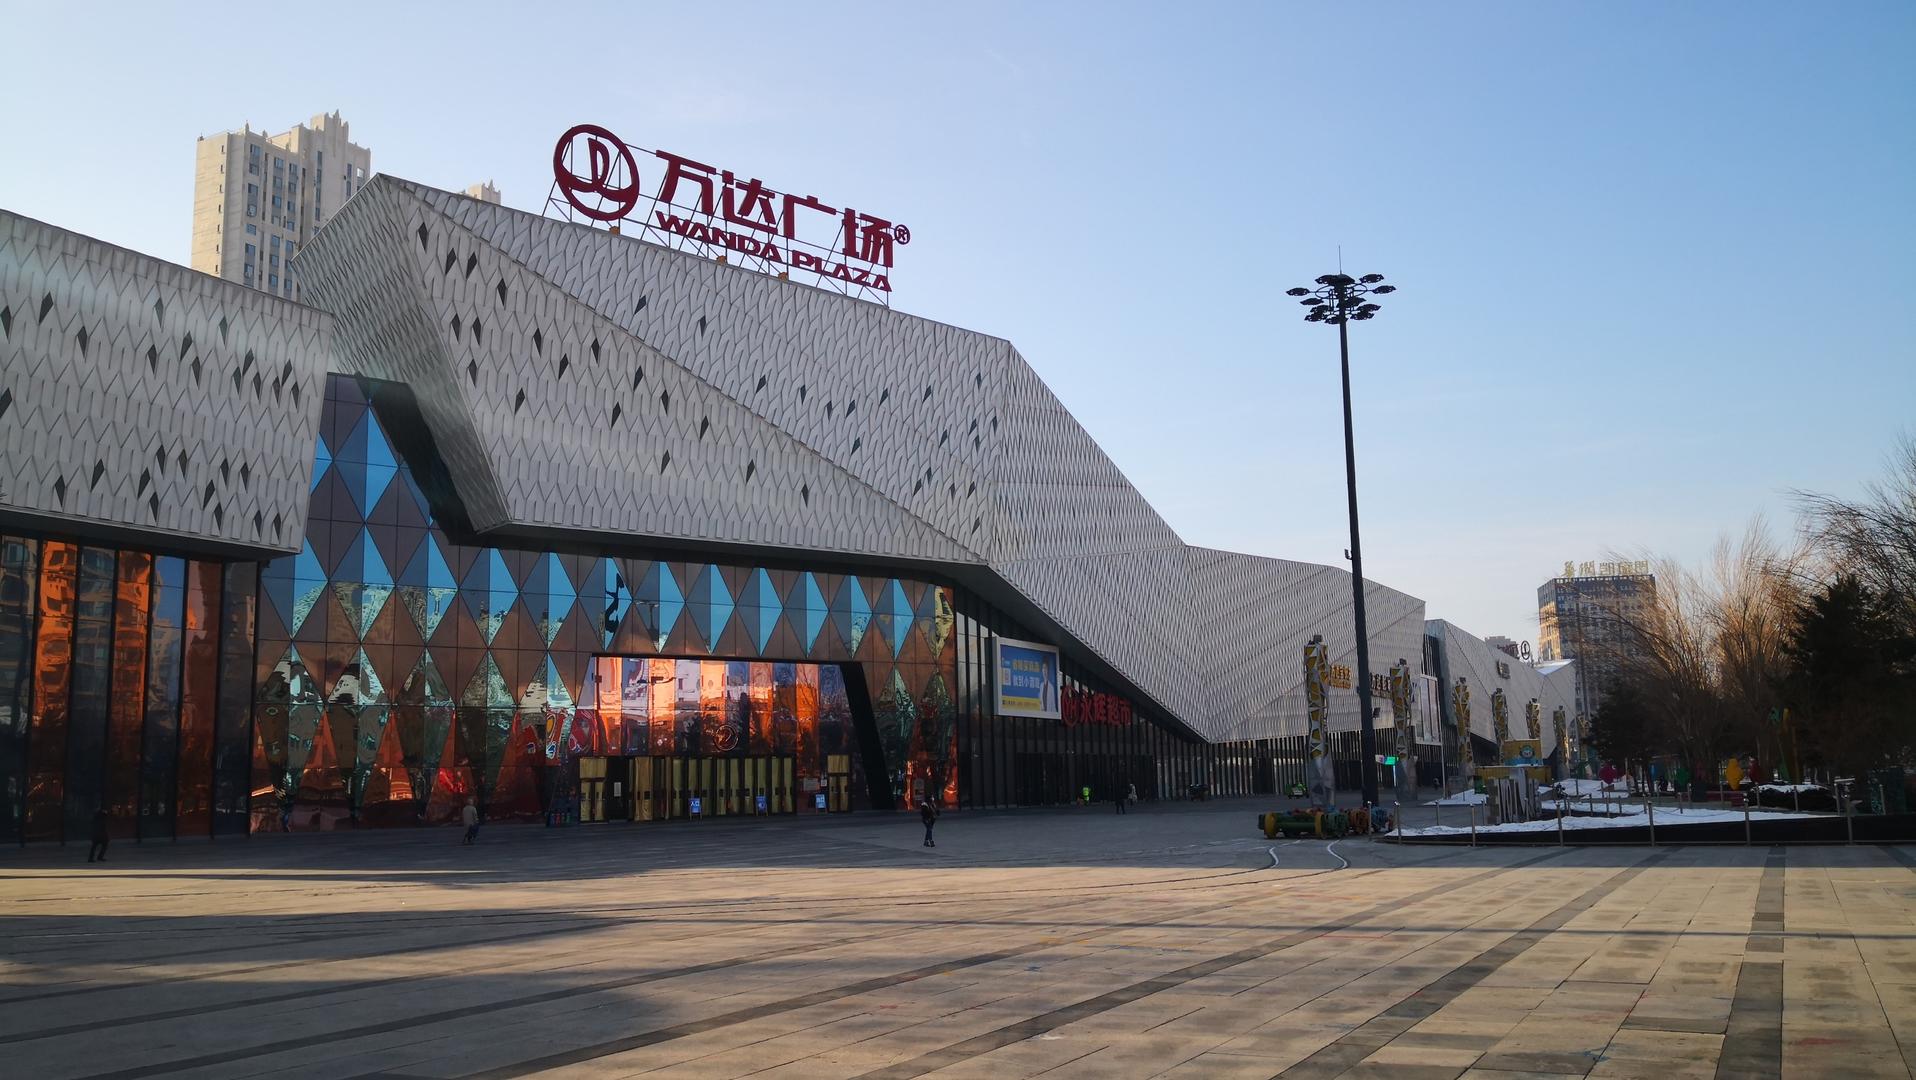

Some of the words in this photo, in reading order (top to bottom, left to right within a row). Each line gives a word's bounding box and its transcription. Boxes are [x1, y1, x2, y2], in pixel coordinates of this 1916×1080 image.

[656, 149, 893, 268] 万达广场
[655, 210, 783, 263] WANDA
[790, 249, 893, 292] PLAZA
[1080, 692, 1132, 727] 永辉超市
